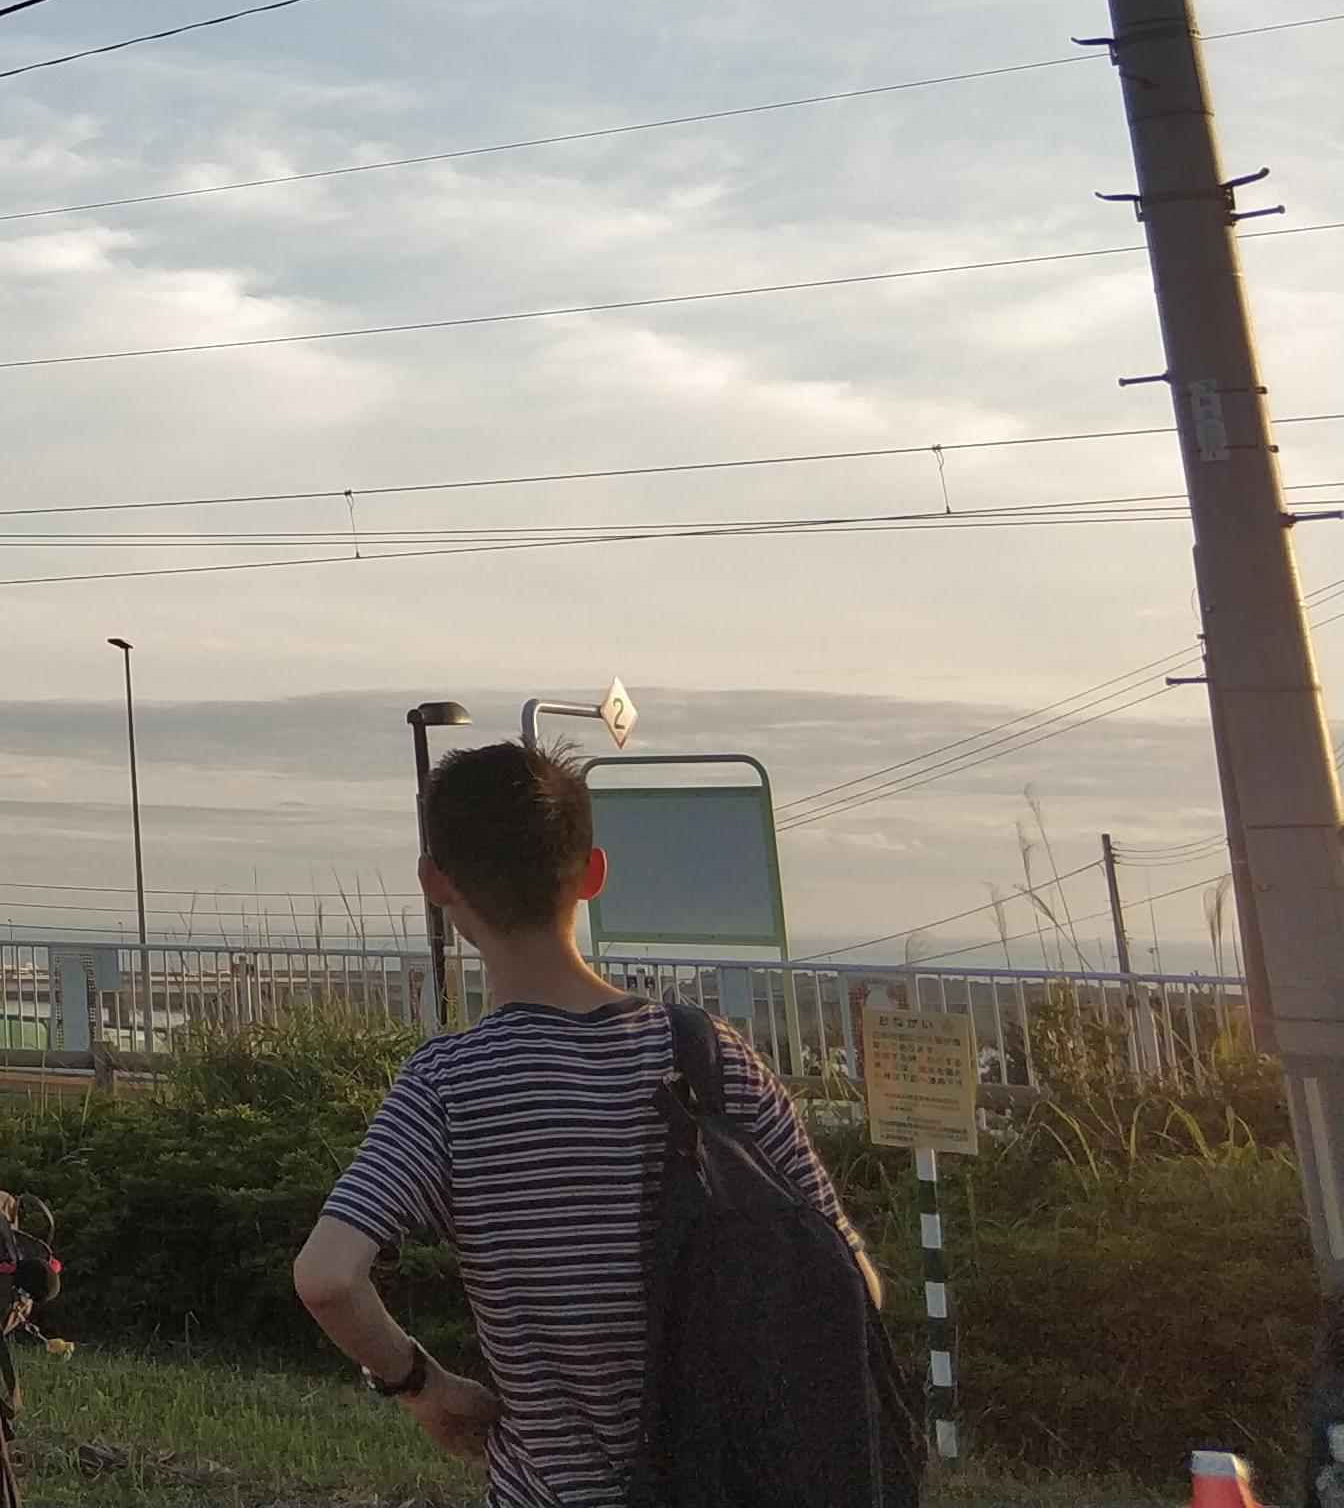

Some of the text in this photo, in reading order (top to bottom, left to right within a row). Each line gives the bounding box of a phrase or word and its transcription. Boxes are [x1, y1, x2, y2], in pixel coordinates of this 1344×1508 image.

[613, 697, 625, 730] 2
[879, 1015, 934, 1030] おねがい
